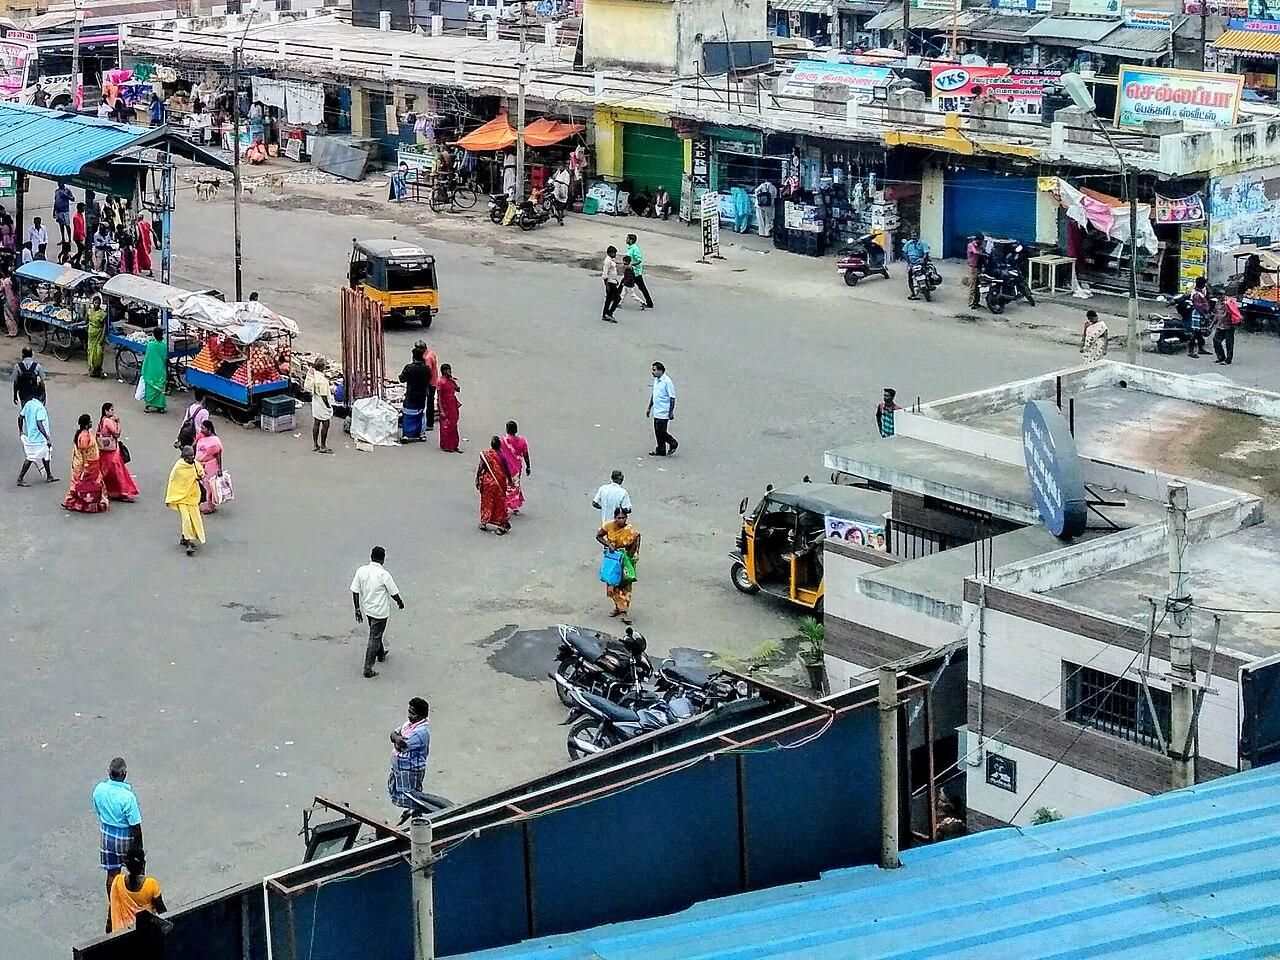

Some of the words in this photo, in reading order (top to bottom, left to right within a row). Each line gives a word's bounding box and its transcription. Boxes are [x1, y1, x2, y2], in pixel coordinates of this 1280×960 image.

[44, 76, 73, 85] SPM
[936, 71, 967, 88] VKS
[1125, 81, 1232, 108] செல்லப்பா
[1134, 101, 1171, 117] பேக்கரி
[1179, 107, 1217, 121] ஸ்வீட்ஸ்
